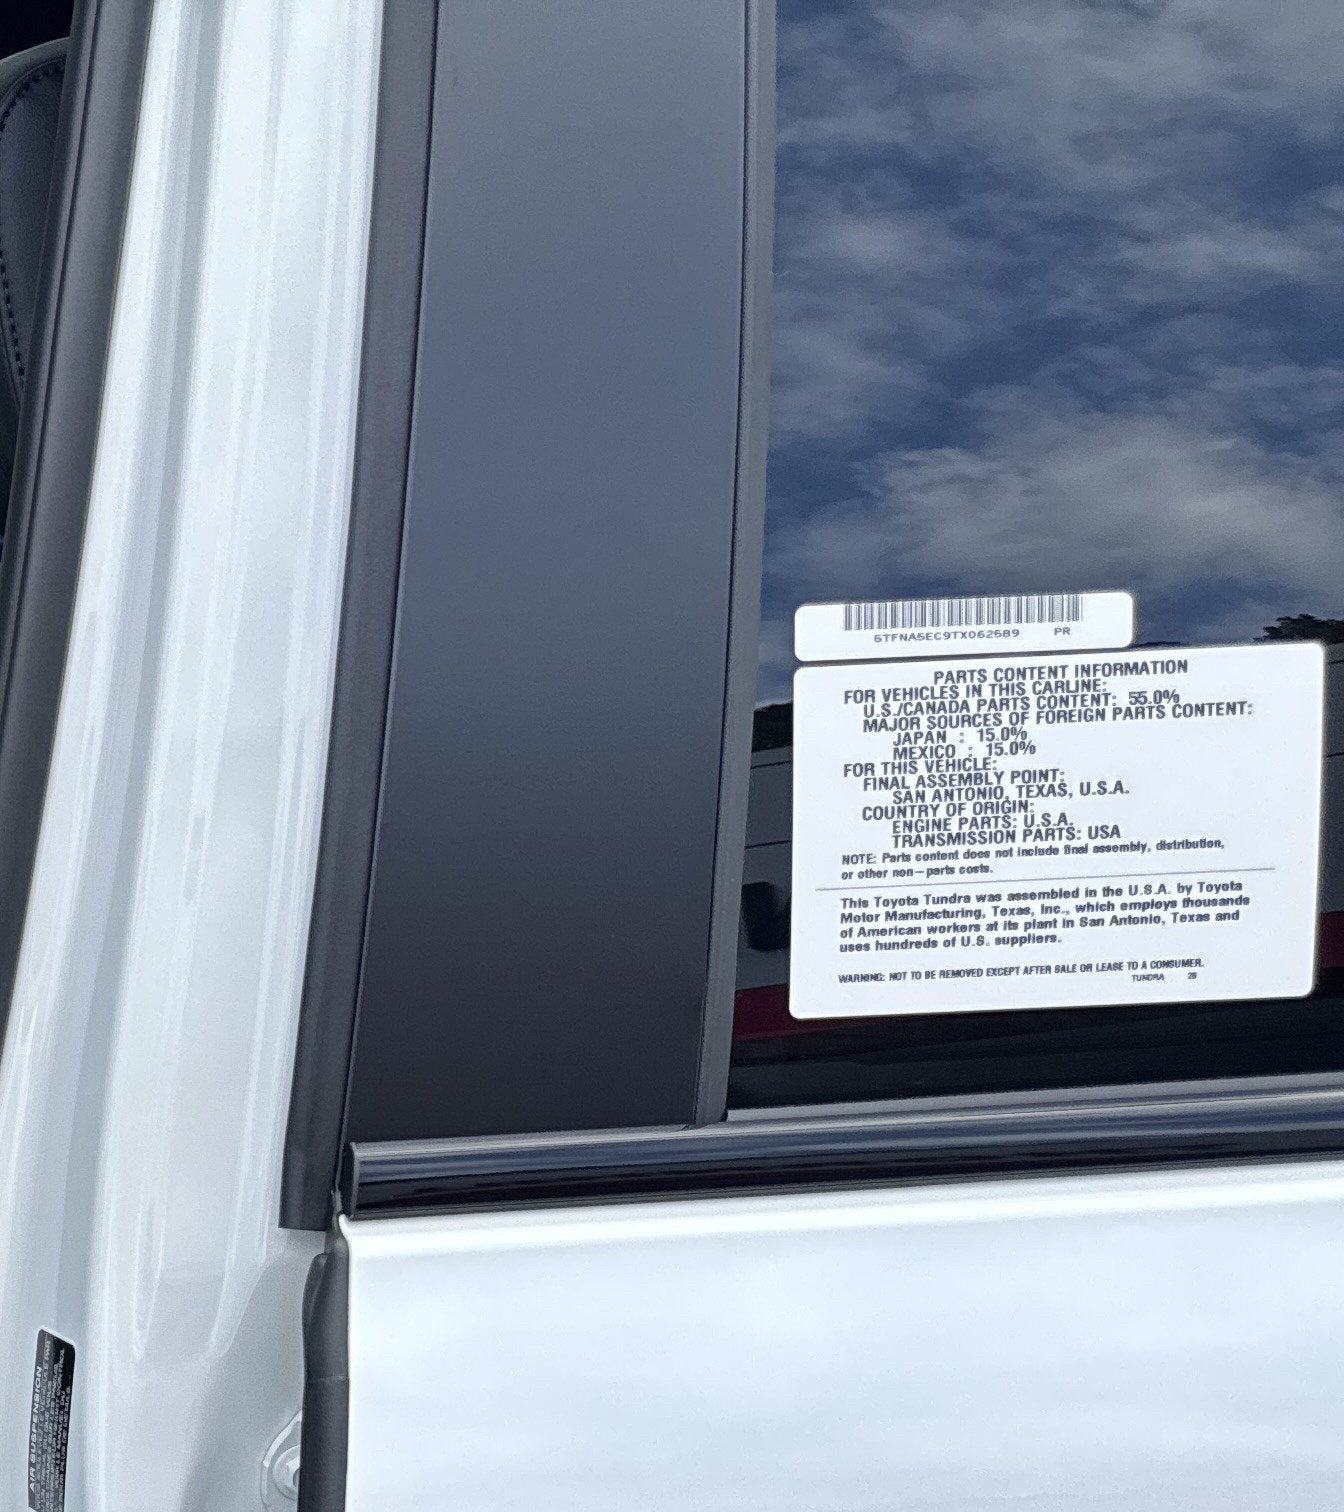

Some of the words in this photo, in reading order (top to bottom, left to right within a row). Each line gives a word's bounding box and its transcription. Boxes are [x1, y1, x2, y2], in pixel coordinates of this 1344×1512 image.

[1054, 626, 1070, 636] PR
[933, 668, 987, 685] PARTS
[993, 664, 1068, 682] CONTENT
[1074, 658, 1187, 679] INFORMATION
[844, 688, 875, 704] FOR
[881, 684, 959, 703] VEHICLES
[965, 683, 982, 698] IN
[988, 681, 1026, 698] THIS
[1032, 677, 1107, 695] CARLINE:
[863, 698, 970, 718] U.S./CANADA
[976, 695, 1030, 713] PARTS
[1036, 691, 1116, 710] CONTENT:
[1128, 688, 1180, 706] 55.0%
[863, 715, 920, 733] MAJOR
[926, 711, 1002, 730] SOURCES
[1008, 710, 1029, 727] OF
[1036, 706, 1105, 725] FOREIGN
[1112, 703, 1166, 721] PARTS
[1171, 700, 1252, 719] CONTENT:
[892, 729, 946, 746] JAPAN
[976, 725, 1027, 742] 15.0%
[892, 743, 955, 761] MEXICO
[985, 739, 1036, 757] 15.0%
[843, 761, 875, 778] FOR
[880, 759, 918, 776] THIS
[924, 755, 996, 774] VEHICLE:
[863, 775, 910, 791] FINAL
[915, 770, 1004, 789] ASSEMBLY
[1010, 767, 1064, 785] POINT:
[892, 788, 925, 805] SAN
[931, 784, 1009, 803] ANTONIO,
[1015, 781, 1072, 799] TEXAS,
[1079, 779, 1129, 796] U.S.A.
[862, 802, 940, 821] COUNTRY
[945, 801, 966, 817] OF
[972, 798, 1034, 816] ORIGIN:
[892, 817, 952, 834] ENGINE
[958, 813, 1017, 831] PARTS:
[1023, 811, 1073, 828] U.S.A.
[892, 828, 1016, 849] TRANSMISSION
[1022, 825, 1081, 843] PARTS:
[1087, 823, 1121, 840] USA
[841, 852, 876, 865] NOTE:
[882, 851, 911, 863] Parts
[915, 849, 959, 862] content
[962, 847, 990, 860] does
[995, 846, 1013, 858] not
[1017, 844, 1059, 857] include
[1063, 842, 1088, 855] final
[1092, 839, 1150, 856] assembly,
[1155, 836, 1224, 852] distribution,
[841, 871, 853, 880] or
[857, 867, 888, 879] other
[958, 862, 993, 874] costs.
[840, 896, 868, 909] This
[873, 894, 919, 910] Toyota
[923, 891, 971, 905] Tundra
[975, 893, 1002, 903] was
[1006, 886, 1079, 902] assembled
[1084, 886, 1097, 898] in
[1101, 884, 1123, 897] the
[1128, 882, 1171, 896] U.S.A.
[1176, 881, 1192, 896] by
[1197, 879, 1242, 895] Toyota
[840, 910, 880, 924] Motor
[884, 905, 985, 924] Manufacturing,
[991, 903, 1034, 919] Texas,
[1040, 902, 1069, 916] Inc.,
[1075, 900, 1115, 913] which
[1120, 897, 1177, 913] employs
[1181, 893, 1250, 908] thousands
[840, 926, 853, 938] of
[856, 923, 921, 938] American
[926, 920, 980, 934] workers
[985, 920, 998, 931] at
[1003, 919, 1018, 931] its
[1023, 917, 1057, 932] plant
[1062, 917, 1074, 928] in
[1079, 915, 1104, 927] San
[1108, 912, 1165, 928] Antonio,
[1171, 910, 1210, 923] Texas
[1214, 909, 1239, 921] and
[839, 942, 870, 953] uses
[875, 936, 938, 951] hundreds
[942, 936, 956, 948] of
[960, 934, 989, 947] U.S.
[994, 931, 1061, 948] suppliers.
[838, 972, 885, 983] WARNING:
[889, 971, 907, 981] NOT
[910, 970, 921, 980] TO
[924, 969, 936, 980] BE
[938, 967, 983, 979] REMOVED
[985, 965, 1020, 977] EXCEPT
[1022, 964, 1051, 975] AFTER
[1054, 963, 1077, 974] SALE
[1079, 963, 1092, 973] OR
[1095, 961, 1123, 972] LEASE
[1126, 960, 1138, 971] TO
[1140, 960, 1147, 970] A
[1149, 957, 1204, 969] CONSUMER.
[29, 1366, 43, 1464] SUSPENSION
